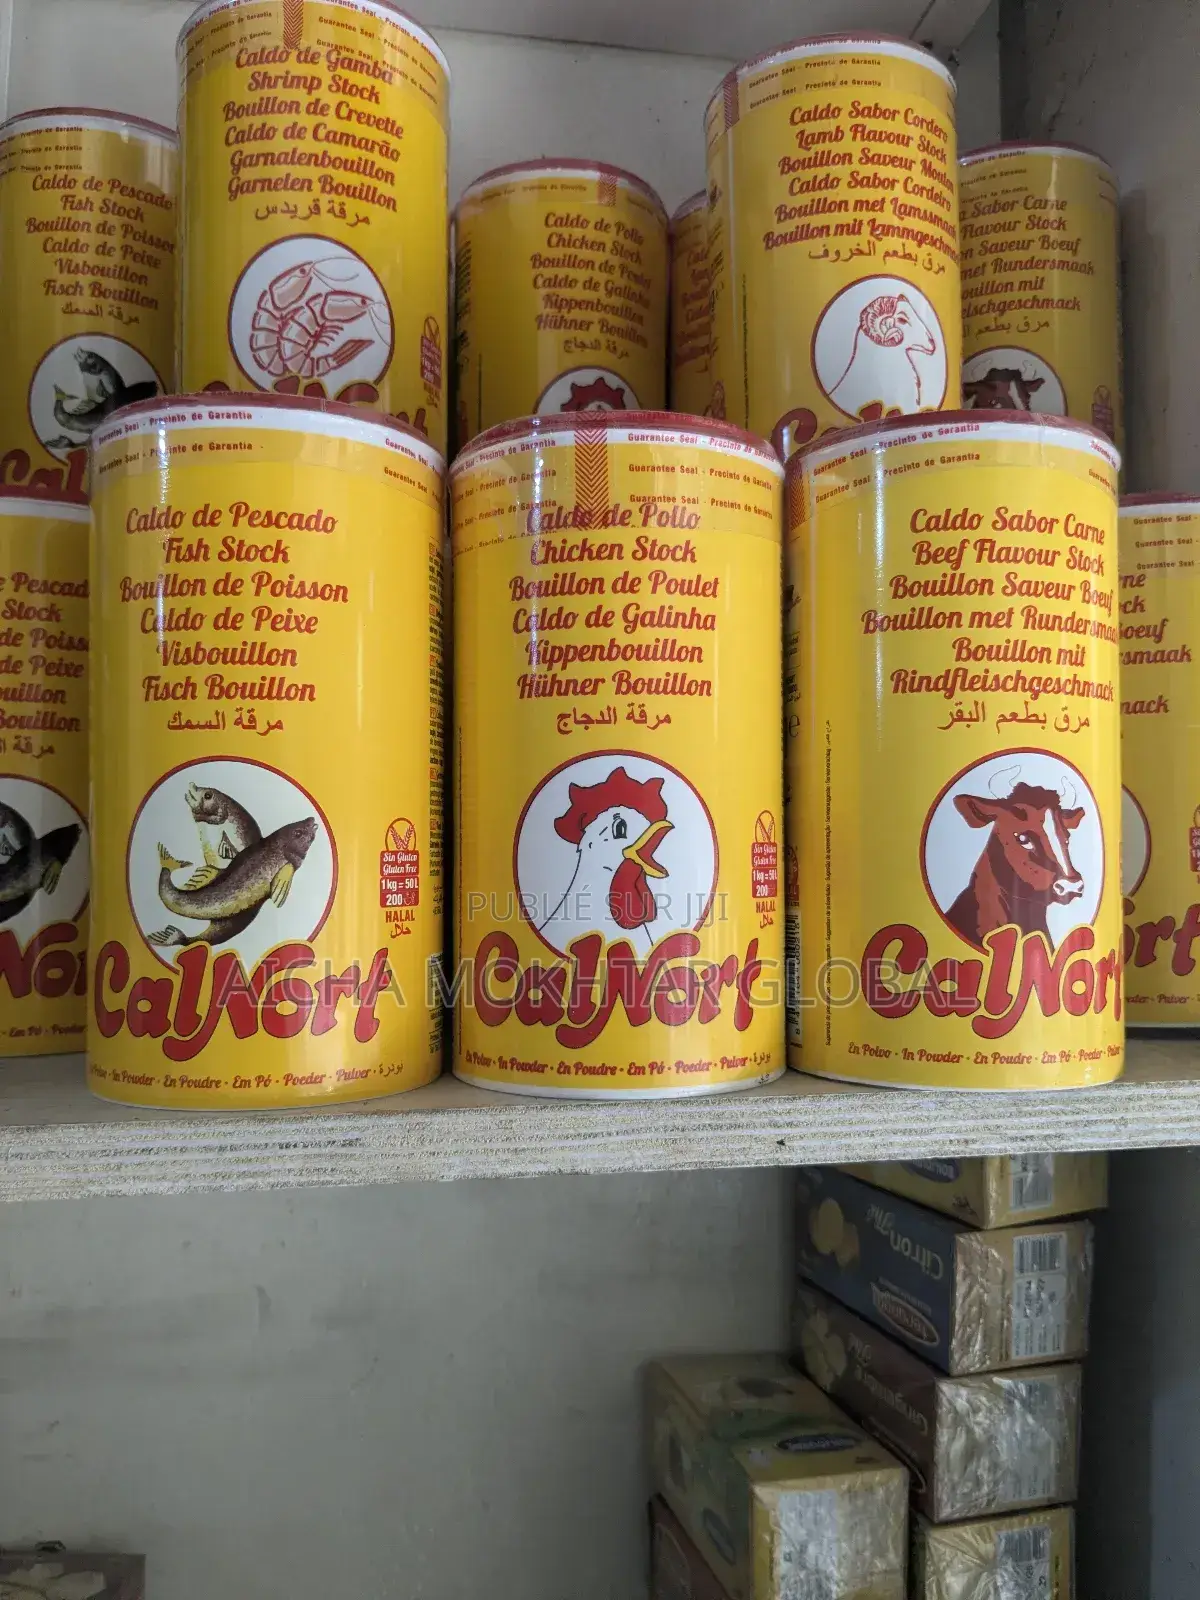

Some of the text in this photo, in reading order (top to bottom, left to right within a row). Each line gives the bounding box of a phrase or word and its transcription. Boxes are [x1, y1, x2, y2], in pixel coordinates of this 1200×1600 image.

[236, 46, 392, 85] Caldo de Gamba
[248, 70, 380, 104] Shrimp Stock
[223, 96, 404, 140] Bouillon de Crevette
[789, 100, 948, 144] Caldo Sabor Cordero
[224, 122, 400, 162] Caldo de Camarão
[796, 126, 844, 150] Lamb
[850, 123, 914, 148] Flavour
[917, 136, 947, 164] Stock
[230, 148, 395, 186] Garnalenbouillon
[778, 148, 852, 176] Bouillon
[858, 148, 916, 172] Saveur
[32, 174, 172, 210] Caldo de Pescado
[228, 173, 397, 212] Garnelen Bouillon
[788, 174, 841, 197] Caldo
[847, 170, 900, 191] Sabor
[903, 176, 952, 212] Cordeiro
[60, 194, 144, 222] Fish Stock
[327, 200, 370, 227] مرقة
[960, 214, 1068, 240] Flavour Stock
[42, 236, 90, 254] Caldo
[95, 242, 116, 257] de
[978, 235, 1082, 258] Saveur Boeuf
[55, 258, 148, 286] Visbouillon
[530, 252, 615, 274] Bouillon de
[43, 280, 158, 310] Fisch Bouillon
[532, 274, 600, 292] Caldo de
[814, 456, 846, 476] Guarantee
[850, 448, 867, 459] Seal
[879, 435, 917, 448] Precinto
[938, 424, 980, 435] Garantia
[816, 453, 980, 504] Guarantee Seal Precinto de Garantia
[127, 501, 338, 534] Caldo de Pescado
[910, 506, 1105, 545] Caldo Sabor Carne
[1134, 514, 1192, 525] Guarantee Seal
[162, 536, 290, 564] Fish Stock
[530, 536, 697, 566] Chicken Stock
[912, 538, 1105, 576] Beef Flavour Stock
[1134, 538, 1192, 548] Guarantee Seal
[1136, 560, 1194, 570] Guarantee Seal
[120, 570, 349, 604] Bouillon de Poisson
[509, 570, 719, 602] Bouillon de Poulet
[889, 572, 1114, 617] Bouillon Saveur Boeuf
[1, 598, 62, 622] Stock
[140, 605, 319, 634] Caldo de Peixe
[512, 603, 716, 634] Caldo de Galinha
[28, 654, 84, 678] Peixe
[156, 640, 298, 668] Visbouillon
[525, 638, 704, 672] Kippenbouillon
[952, 637, 1086, 668] Bouillon mit
[142, 674, 316, 702] Fisch Bouillon
[517, 670, 712, 700] Hühner Bouillon
[890, 667, 1114, 702] Rindfleischgeschmack
[167, 706, 284, 736] مرقة السمك
[557, 702, 672, 734] مرقة الدجاج
[938, 700, 1090, 734] مرق بطعم البقر
[383, 864, 404, 876] Gluten
[384, 852, 418, 863] Sin Gluten
[386, 894, 402, 905] 200
[756, 885, 768, 896] 200
[386, 910, 415, 922] HALAL
[756, 900, 776, 913] HALAL
[390, 923, 411, 939] حلال
[94, 941, 392, 1062] CalNort
[474, 931, 761, 1048] CalNort
[848, 1042, 860, 1054] En
[862, 1044, 890, 1058] Polvo
[902, 1048, 914, 1060] In
[917, 1049, 964, 1064] Powder
[973, 1052, 988, 1064] En
[990, 1052, 1032, 1064] Poudre
[1041, 1052, 1056, 1064] Em
[1058, 1050, 1071, 1063] Pó
[1078, 1048, 1102, 1062] Poeder
[122, 1070, 155, 1086] Powder
[164, 1075, 176, 1087] En
[179, 1075, 222, 1088] Poudre
[232, 1076, 252, 1088] Em
[255, 1074, 272, 1087] Pó
[283, 1072, 326, 1086] Poeder
[336, 1068, 371, 1082] Pulver
[890, 1234, 944, 1280] Citron
